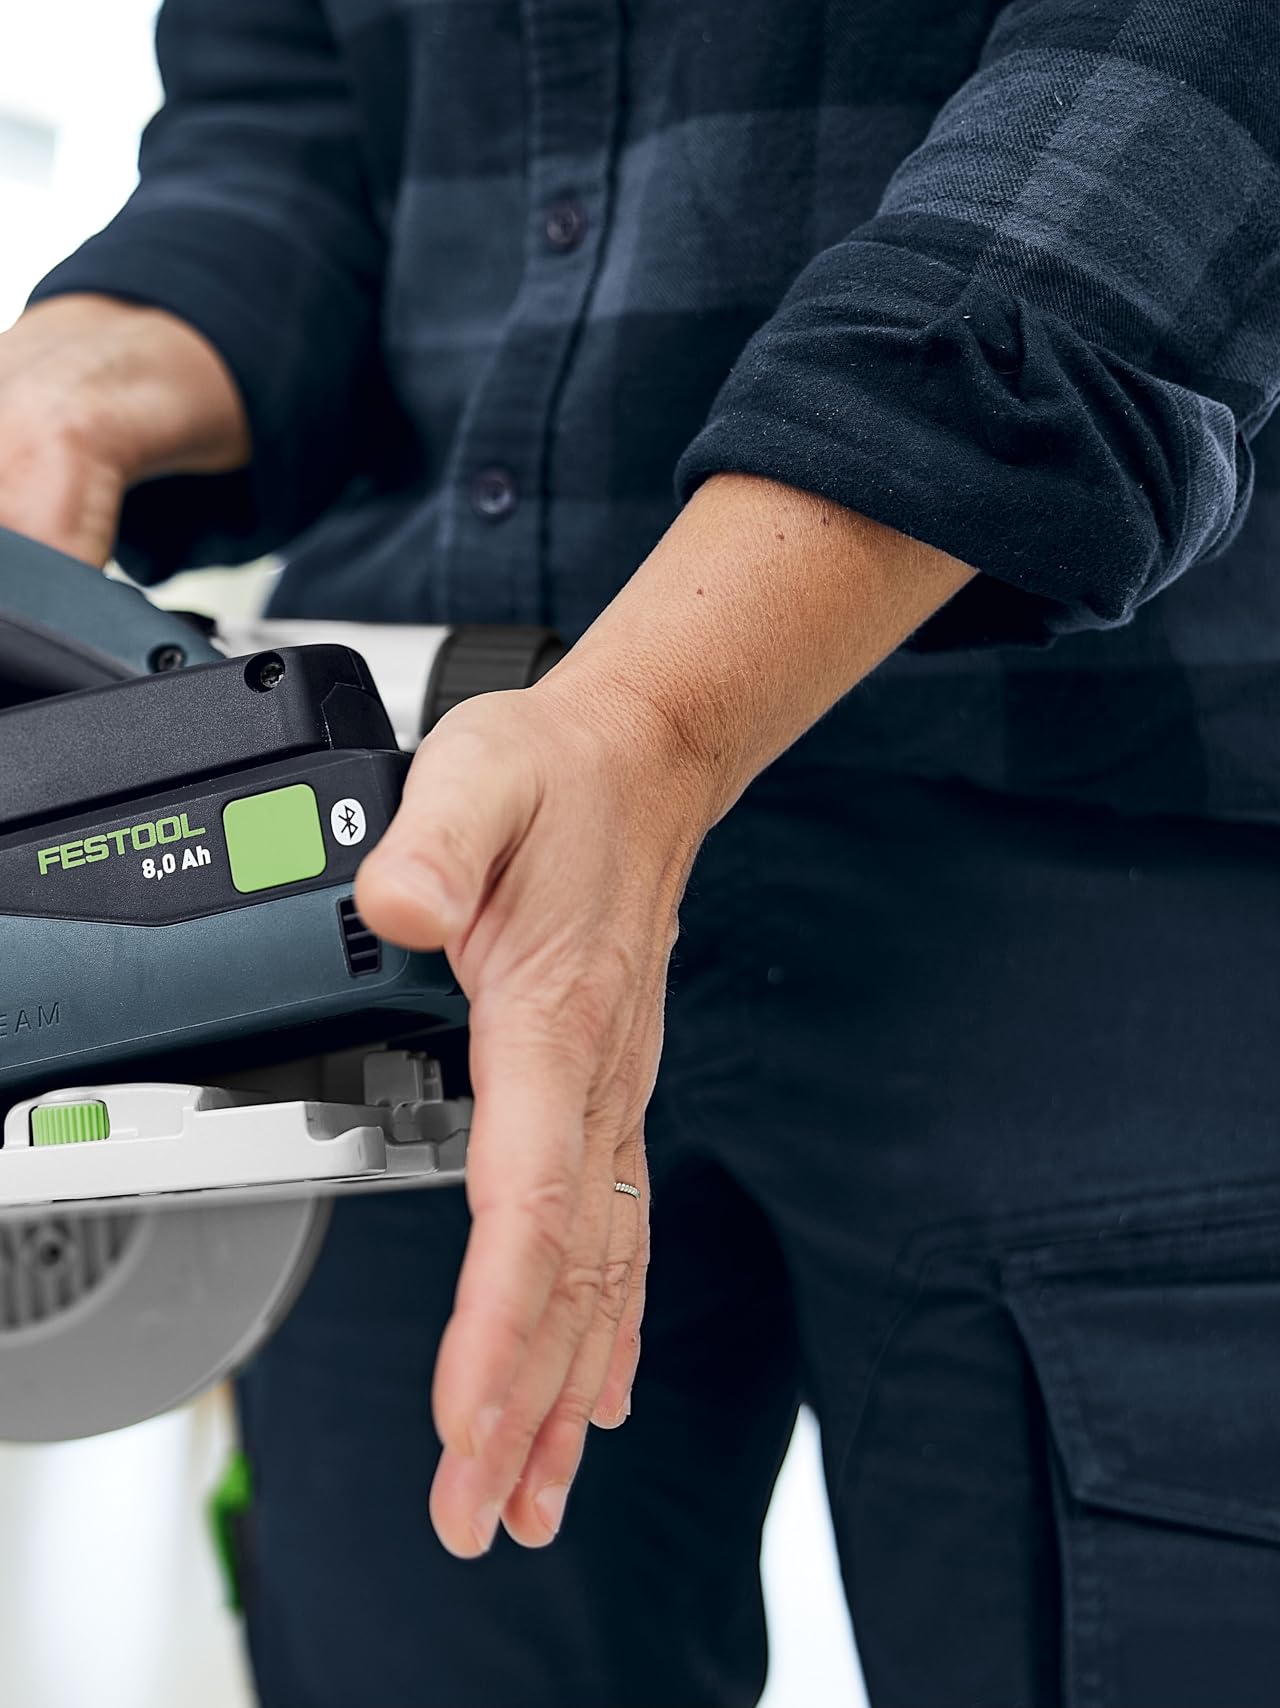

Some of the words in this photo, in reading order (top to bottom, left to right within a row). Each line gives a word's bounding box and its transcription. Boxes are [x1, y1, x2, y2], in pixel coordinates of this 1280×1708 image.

[37, 813, 206, 875] FESTOOL
[142, 853, 176, 880] 8,0
[182, 845, 212, 870] Ah
